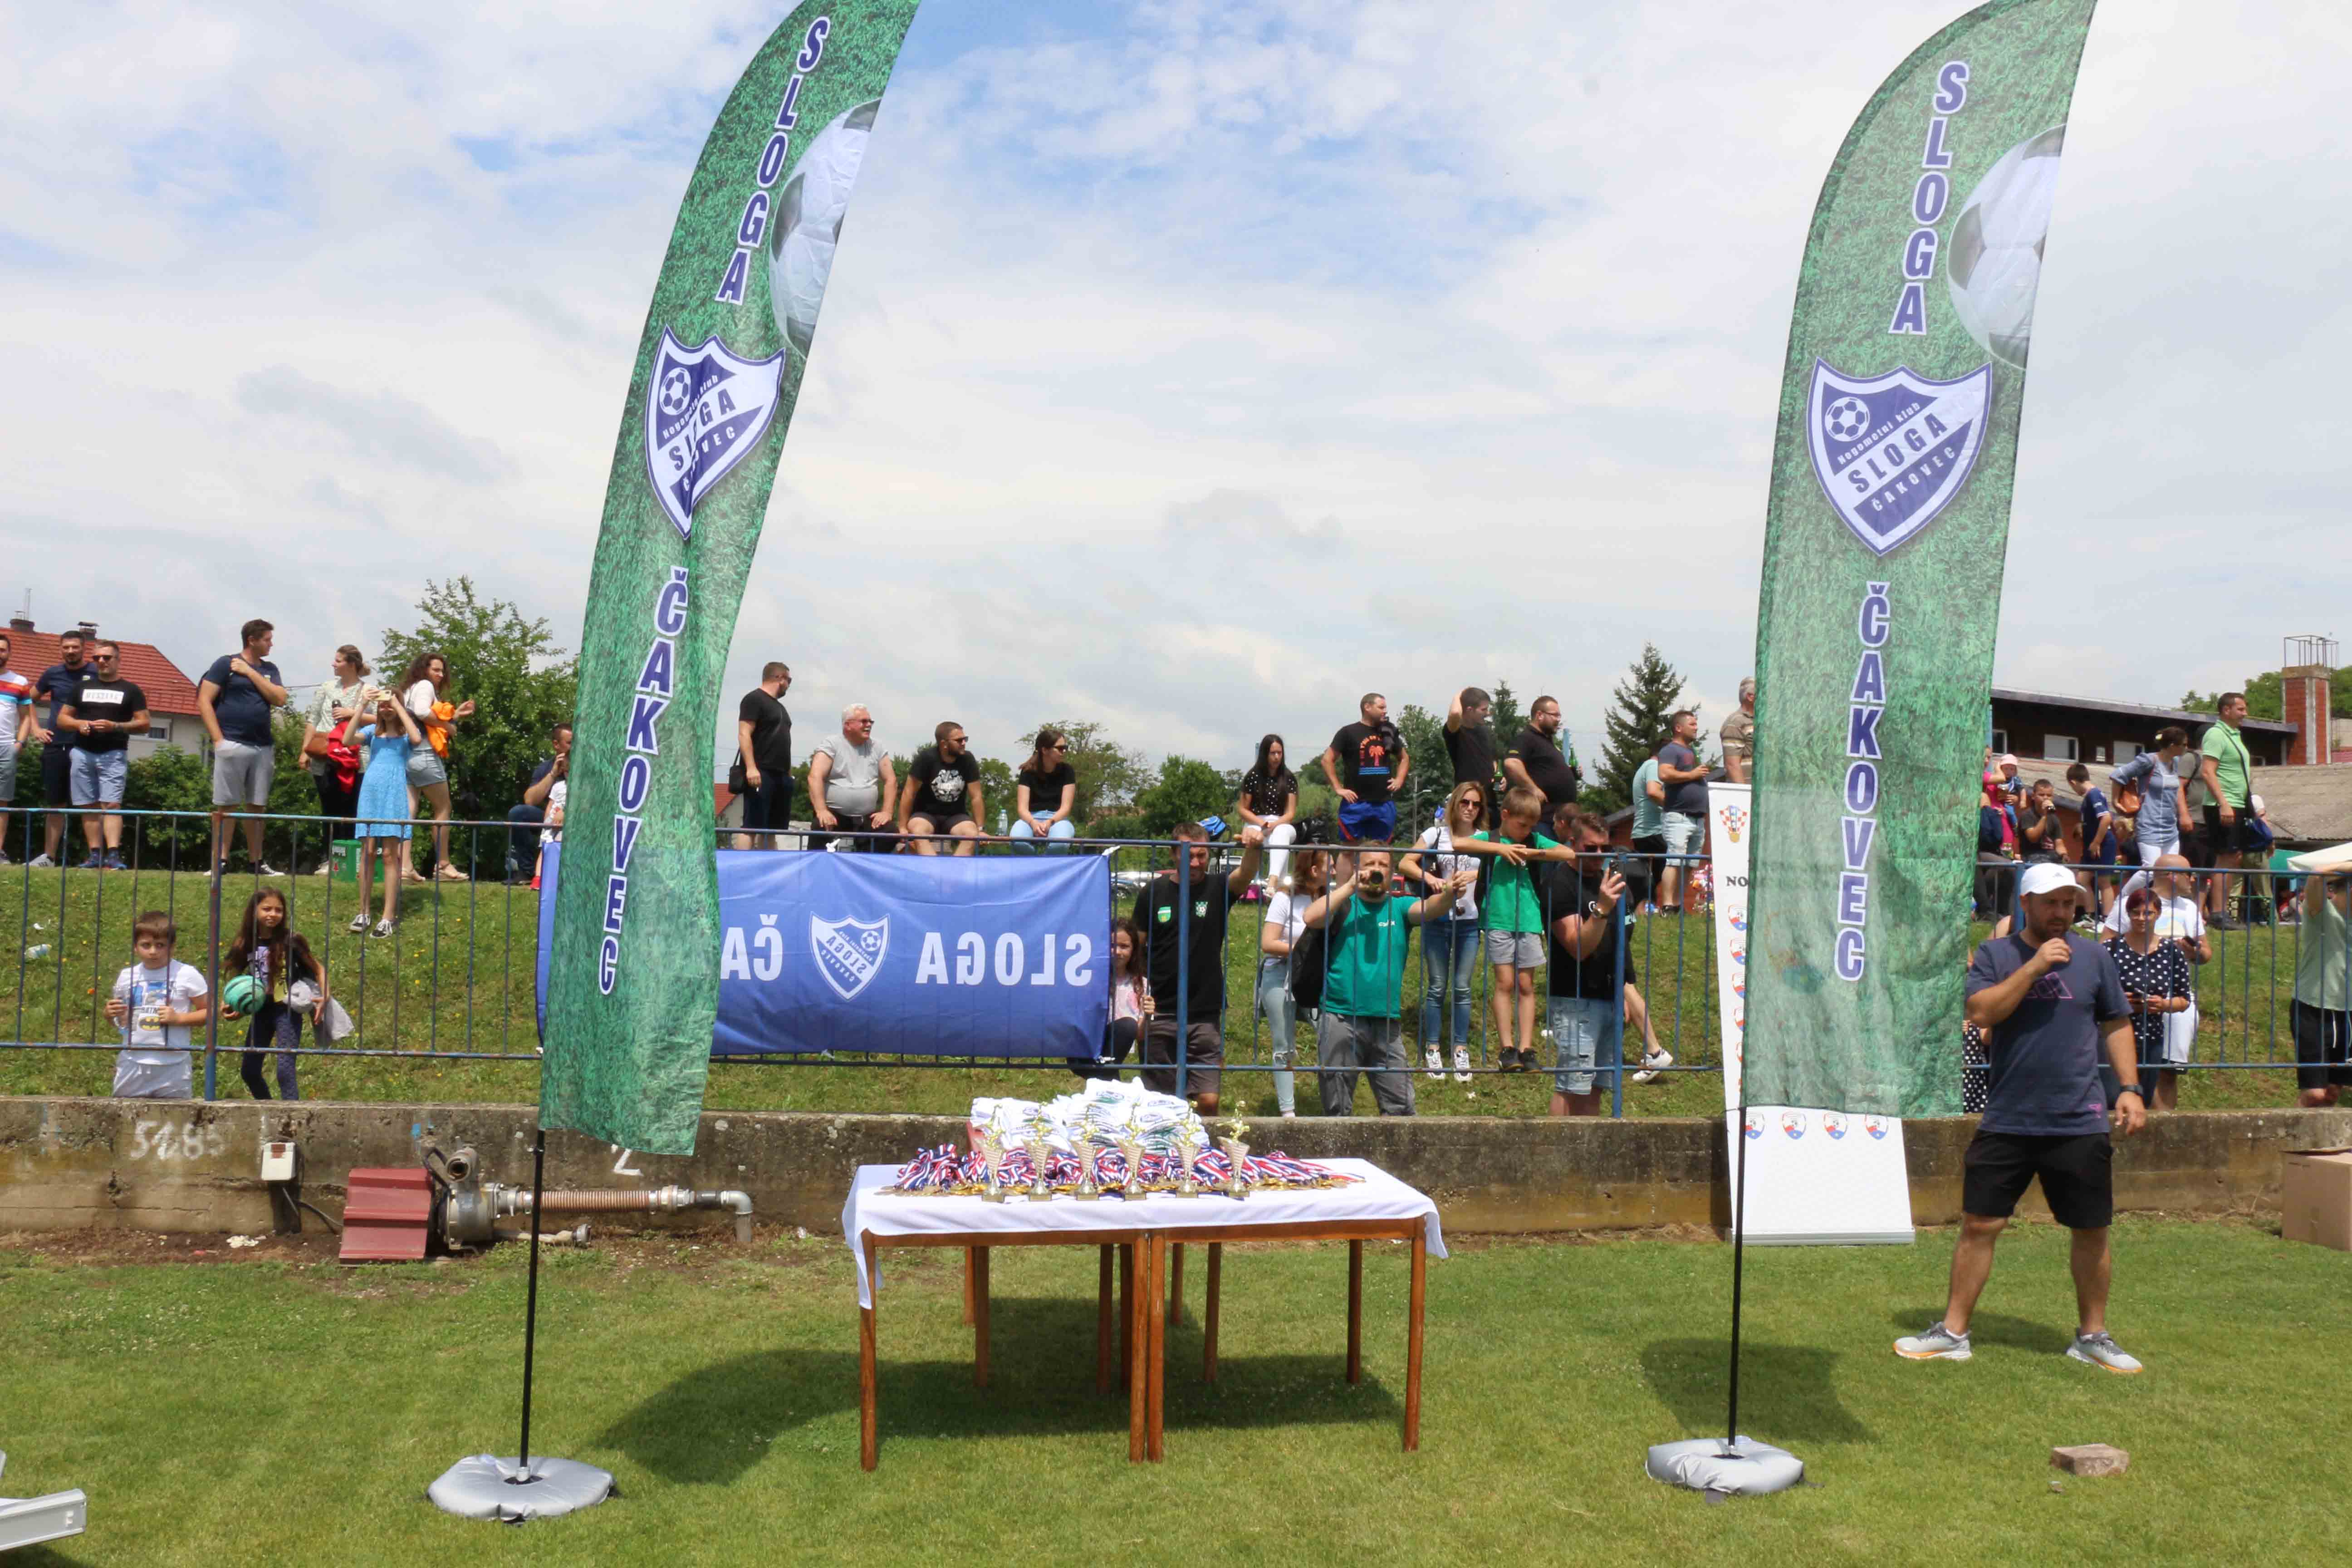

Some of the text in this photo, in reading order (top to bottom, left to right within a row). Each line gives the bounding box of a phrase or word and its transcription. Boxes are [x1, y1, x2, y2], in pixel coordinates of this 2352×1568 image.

[714, 16, 830, 305] SLOGA
[1888, 61, 1970, 335] SLOGA
[669, 388, 736, 471] SLGA
[1837, 402, 1920, 465] Nogometni klub
[1847, 413, 1947, 493] SLOGA
[1872, 446, 1955, 511] ČAKOVEC
[598, 566, 689, 995] ČAKOVEC
[1834, 581, 1891, 981] ČAKOVEC
